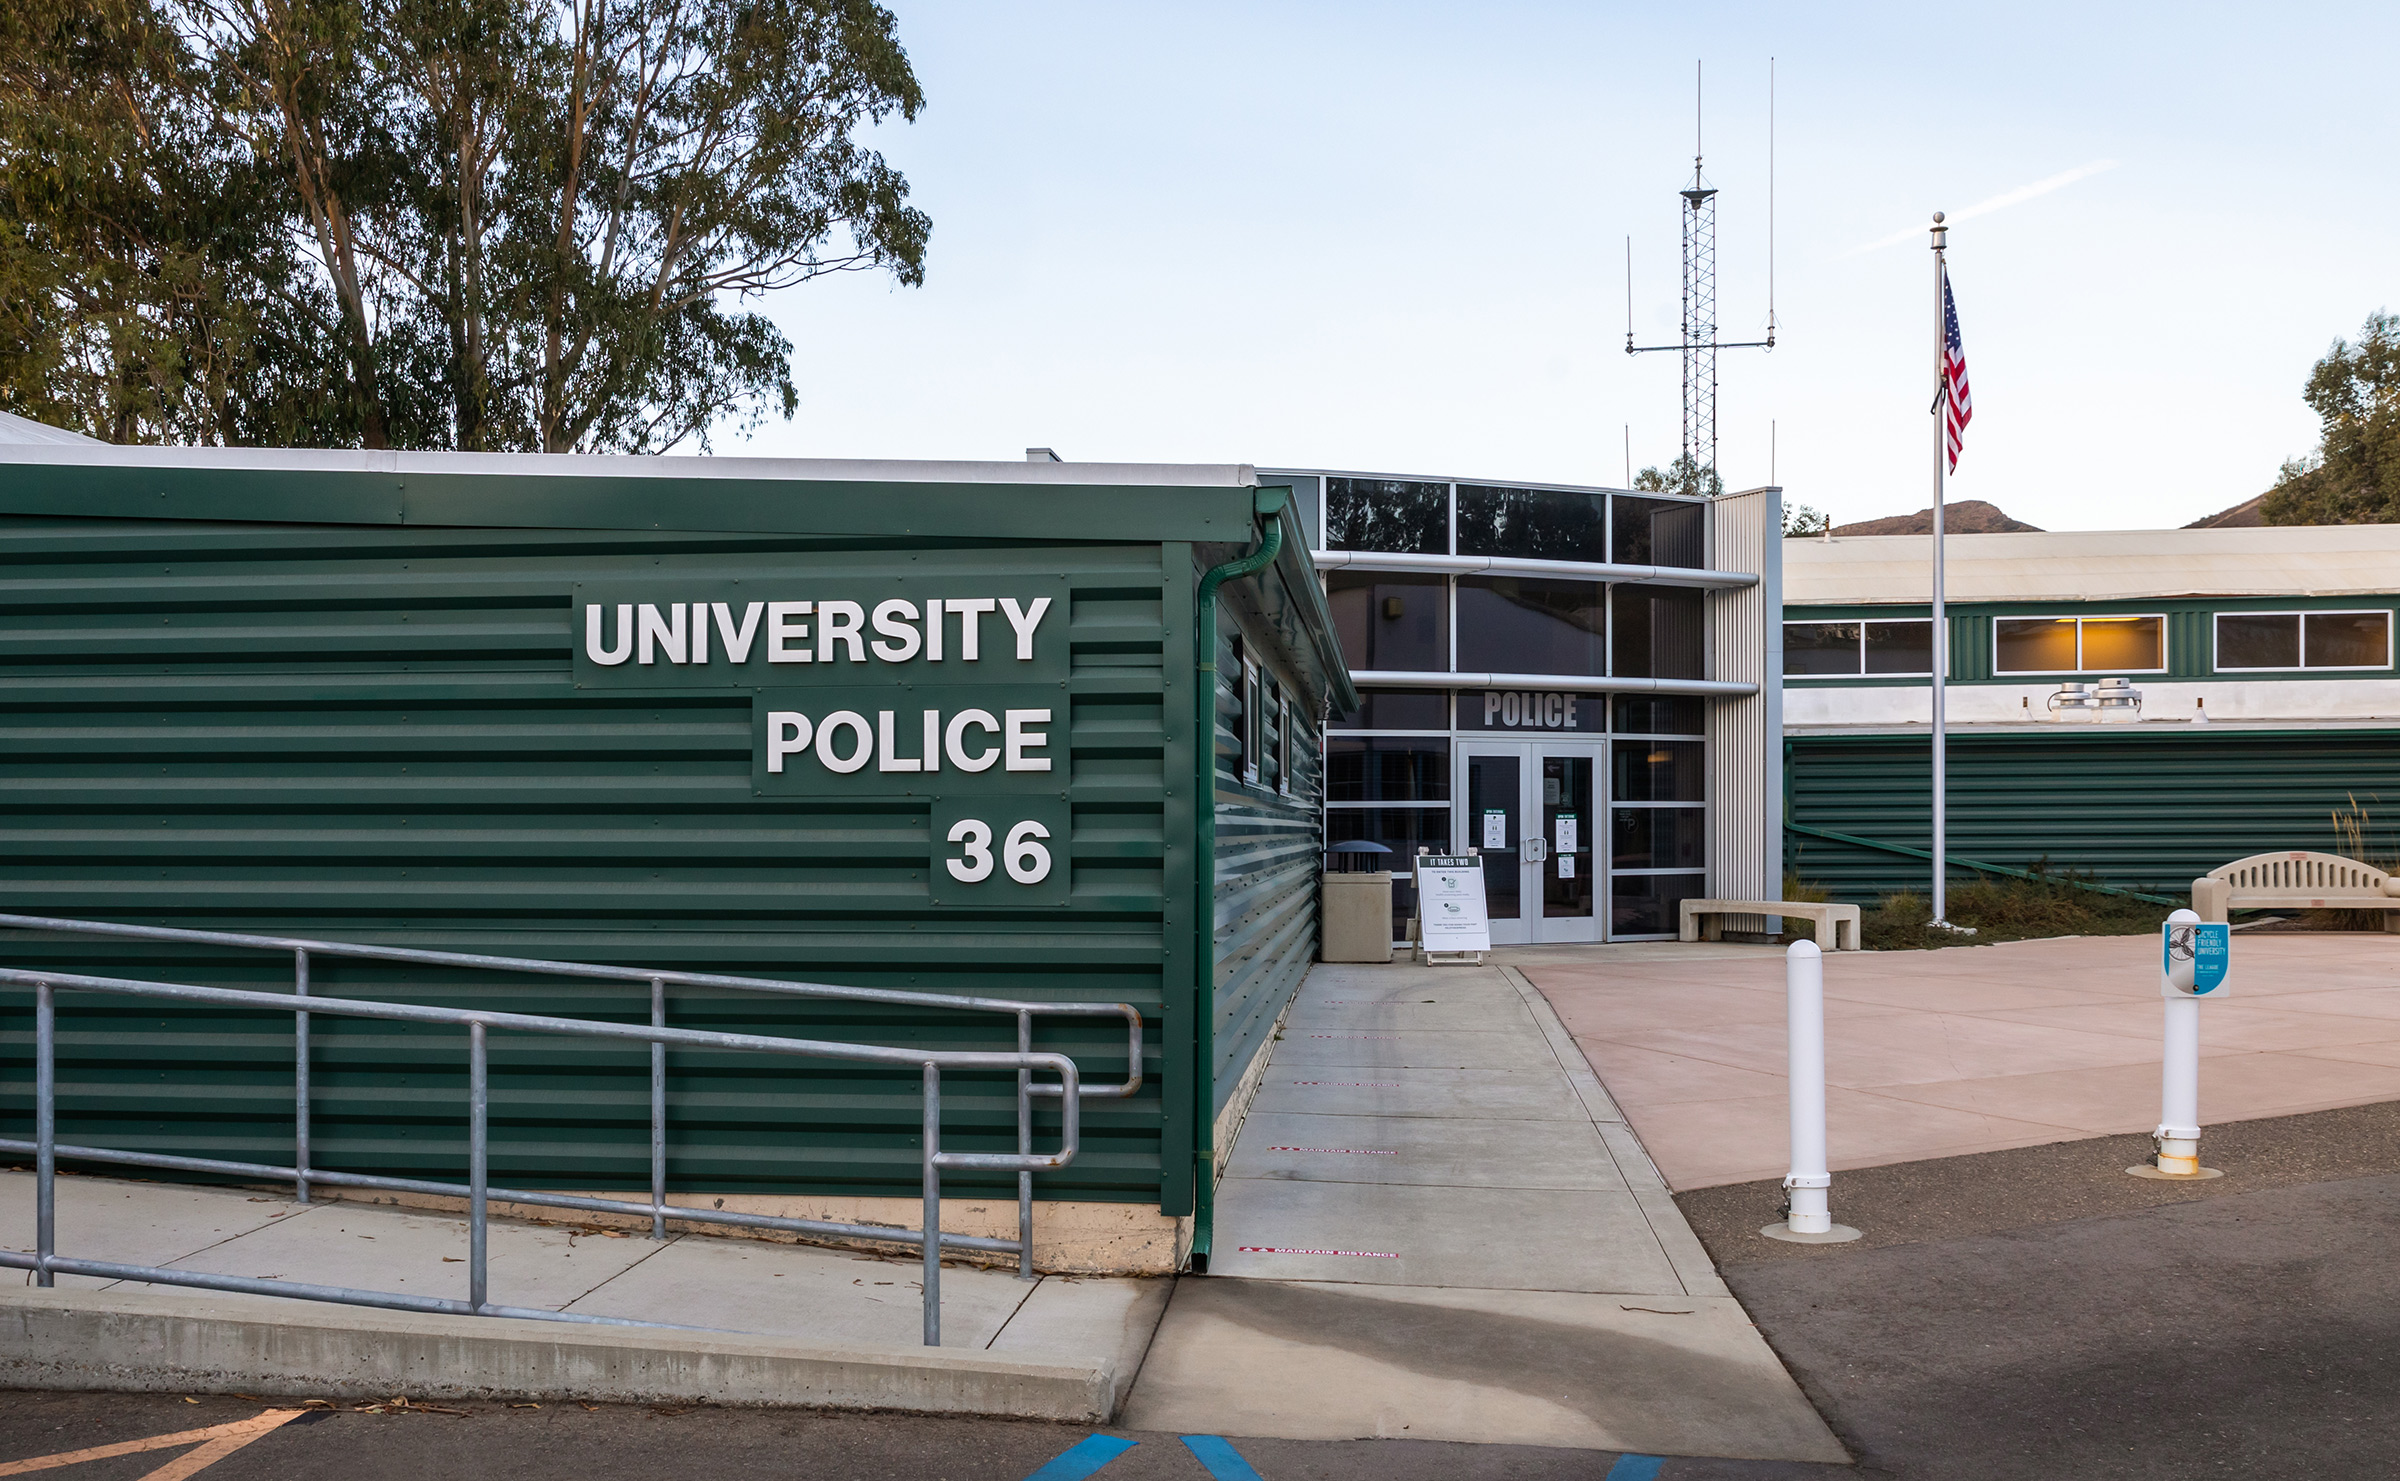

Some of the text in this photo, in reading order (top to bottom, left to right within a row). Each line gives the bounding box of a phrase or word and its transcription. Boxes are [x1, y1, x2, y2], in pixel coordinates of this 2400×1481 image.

[585, 598, 1052, 666] UNIVERSITY
[1484, 691, 1577, 728] POLICE
[766, 708, 1052, 774] POLICE
[945, 818, 1052, 885] 36
[1430, 858, 1469, 866] IT TAKES TWO
[2198, 939, 2222, 947] FRIENDLY
[2198, 947, 2226, 955] UNIVERSITY
[1338, 1250, 1397, 1258] DISTANCE
